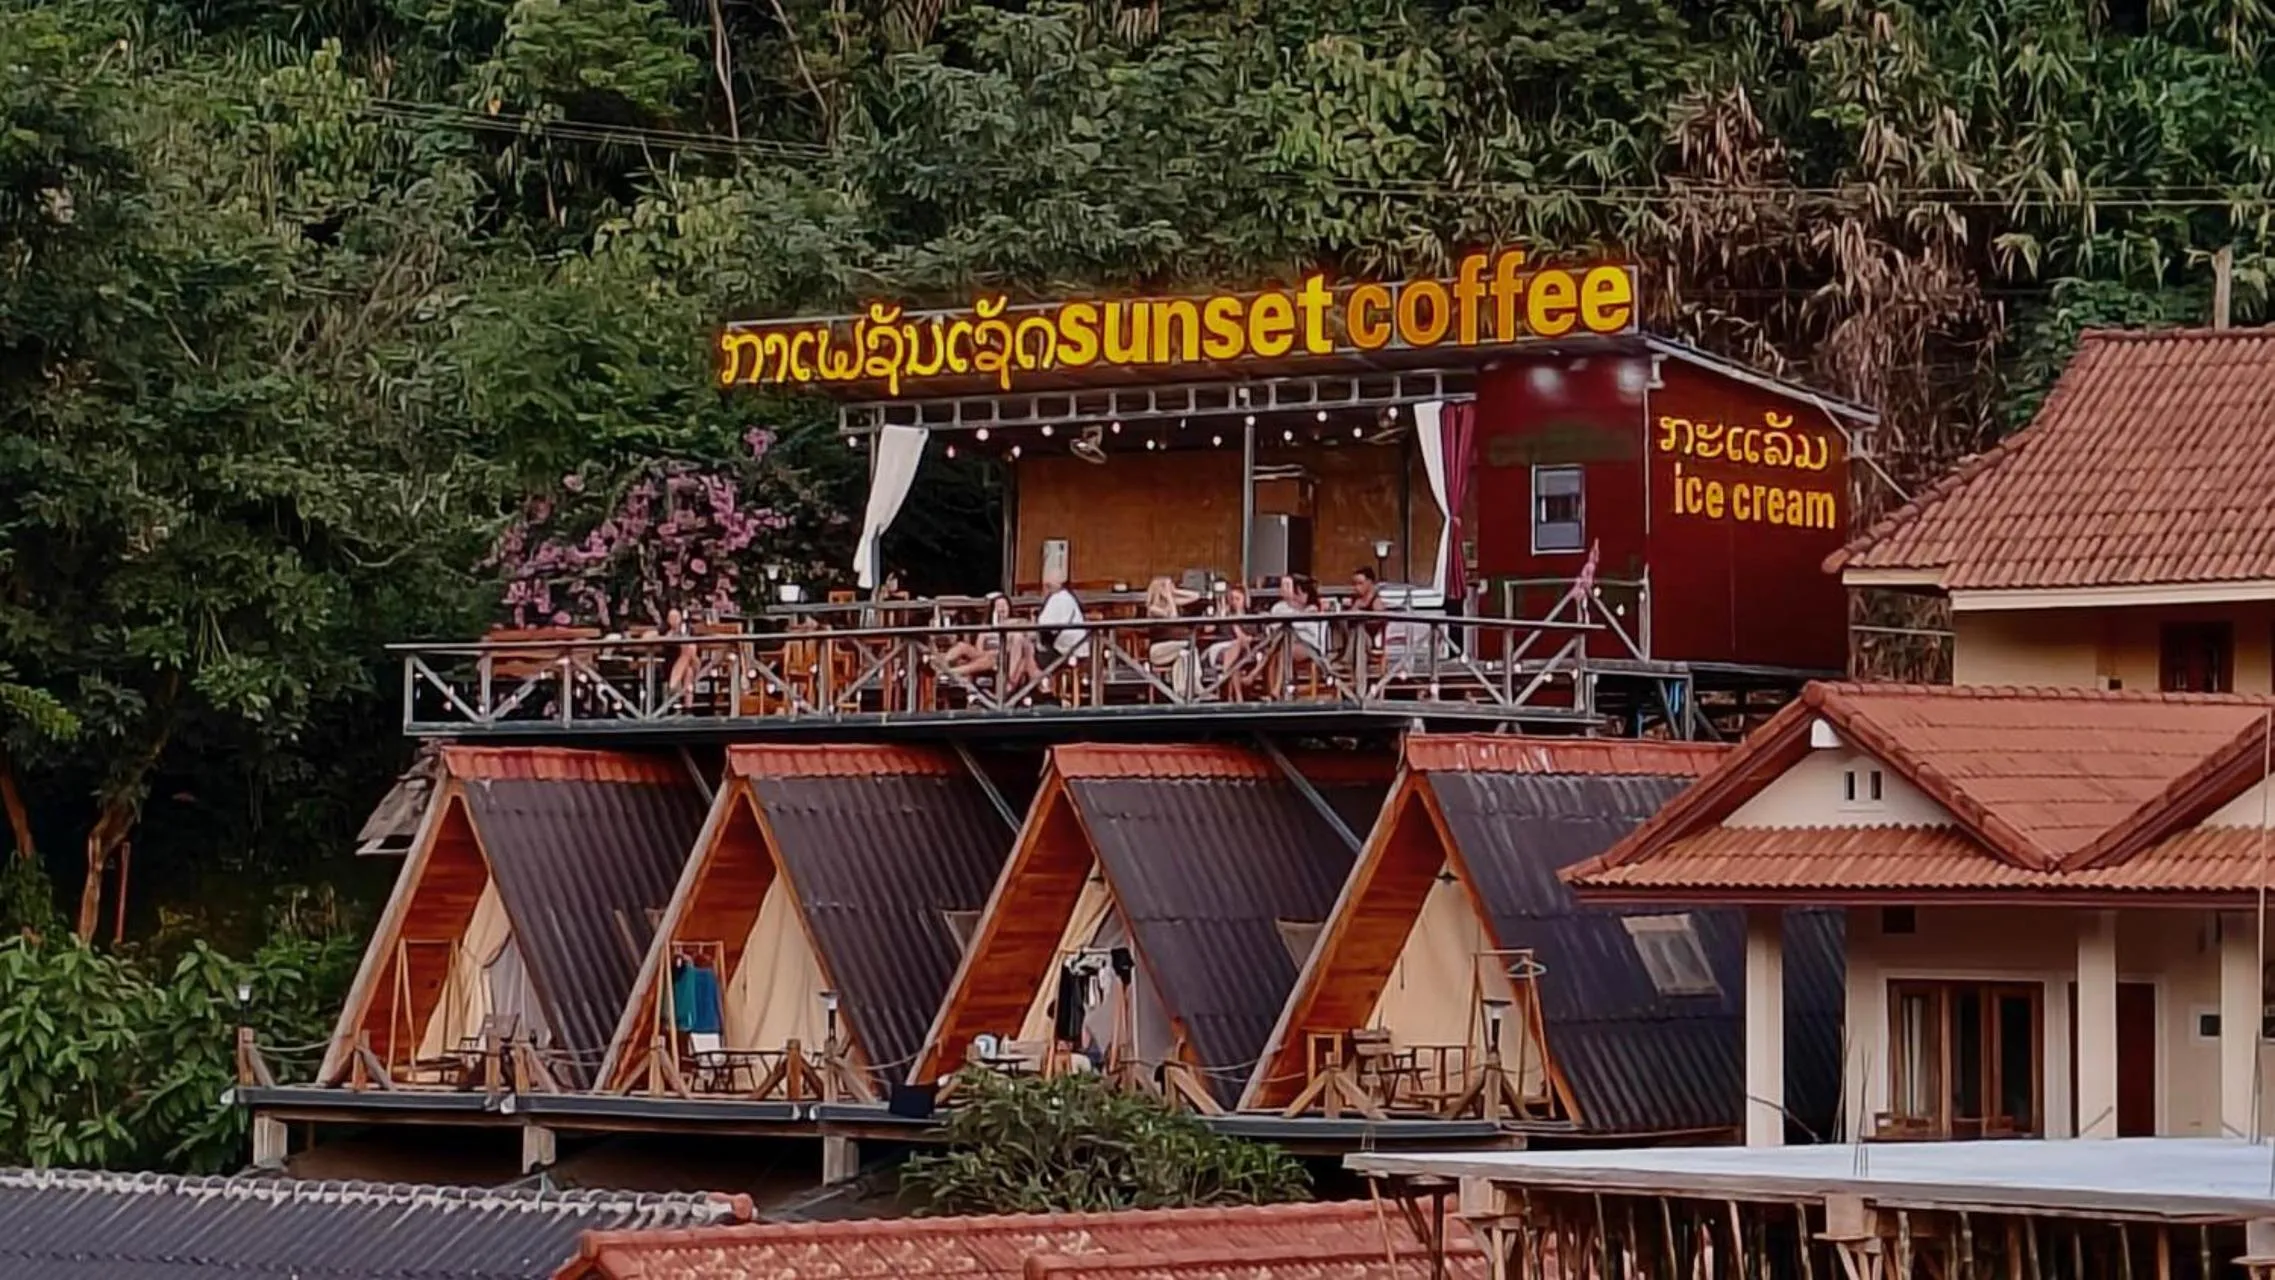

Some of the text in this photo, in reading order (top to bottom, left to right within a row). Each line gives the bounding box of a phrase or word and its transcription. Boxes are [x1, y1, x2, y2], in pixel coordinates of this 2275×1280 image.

[1055, 249, 1633, 366] sunset coffee
[1673, 462, 1837, 530] ice cream
